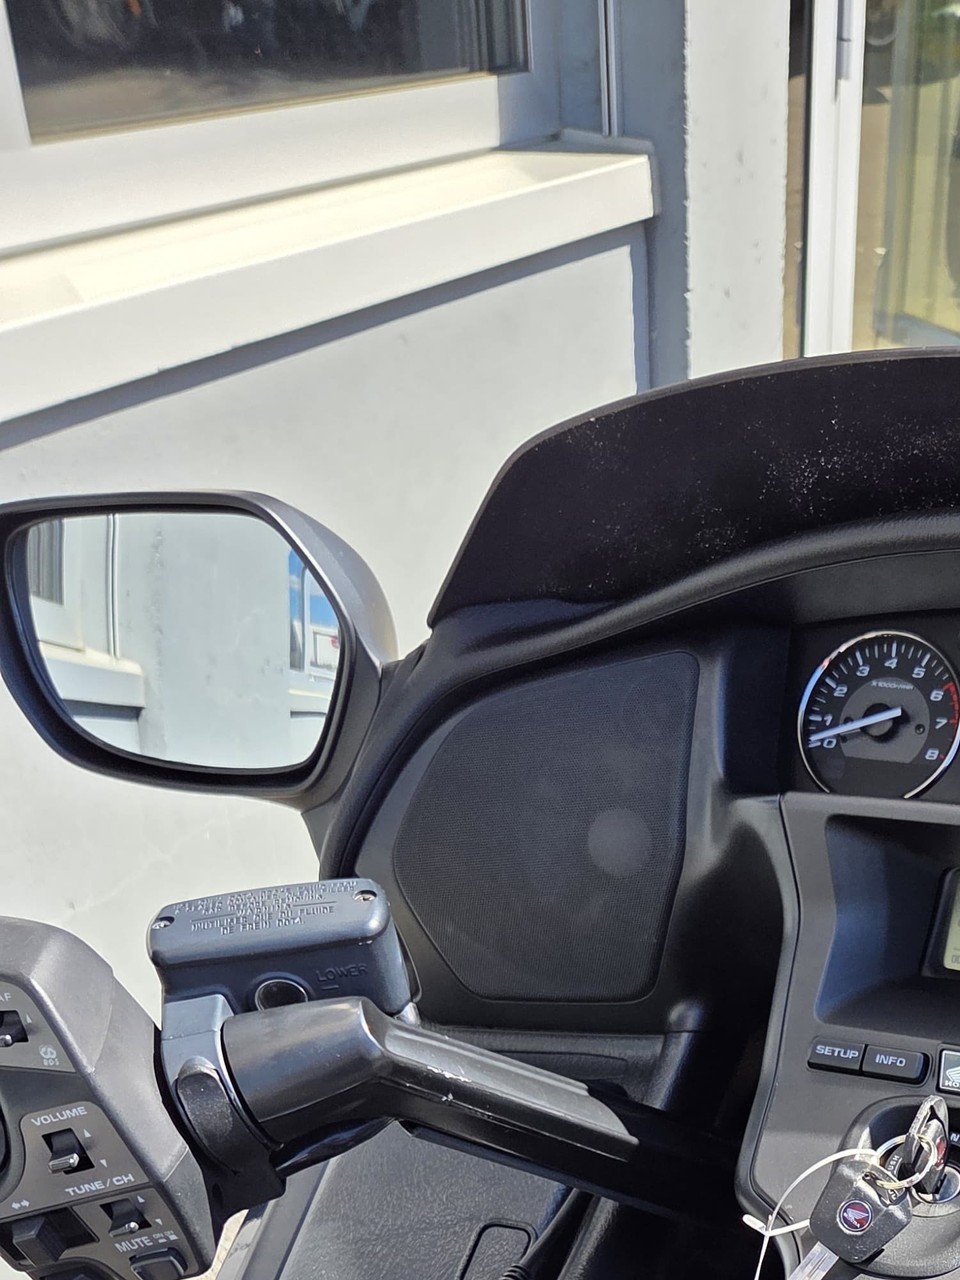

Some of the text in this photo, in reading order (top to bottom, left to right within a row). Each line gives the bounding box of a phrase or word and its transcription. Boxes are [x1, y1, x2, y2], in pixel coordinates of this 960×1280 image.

[884, 658, 898, 669] 4
[856, 666, 871, 677] 3
[912, 667, 926, 679] 5
[833, 686, 848, 697] 2
[930, 690, 944, 702] 6
[824, 715, 833, 726] 1
[935, 718, 948, 729] 7
[823, 738, 837, 749] 0
[925, 749, 939, 760] 8
[316, 963, 368, 982] LOWER
[815, 1044, 906, 1067] SETUP INFO
[31, 1106, 88, 1127] VOLUME
[114, 1235, 154, 1253] MUTE
